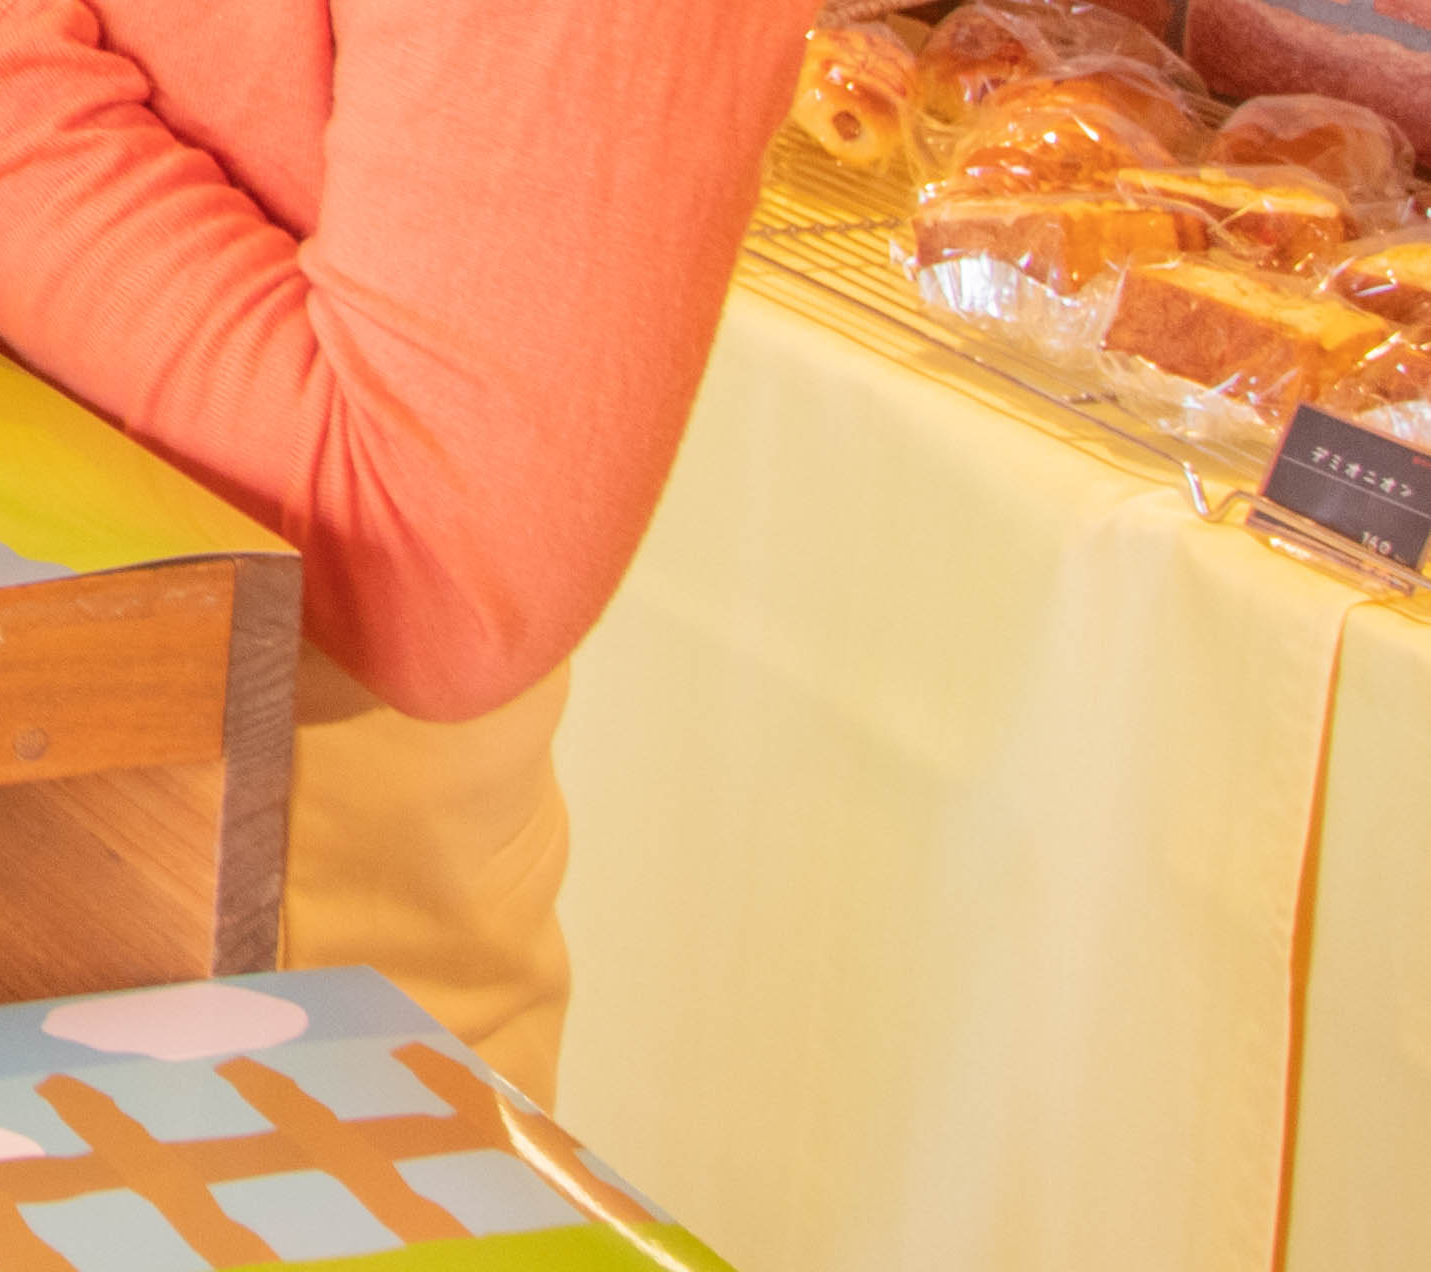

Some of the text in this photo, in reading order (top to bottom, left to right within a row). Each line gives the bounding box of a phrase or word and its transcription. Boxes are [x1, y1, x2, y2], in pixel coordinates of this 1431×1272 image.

[1311, 445, 1413, 498] デミオニオン
